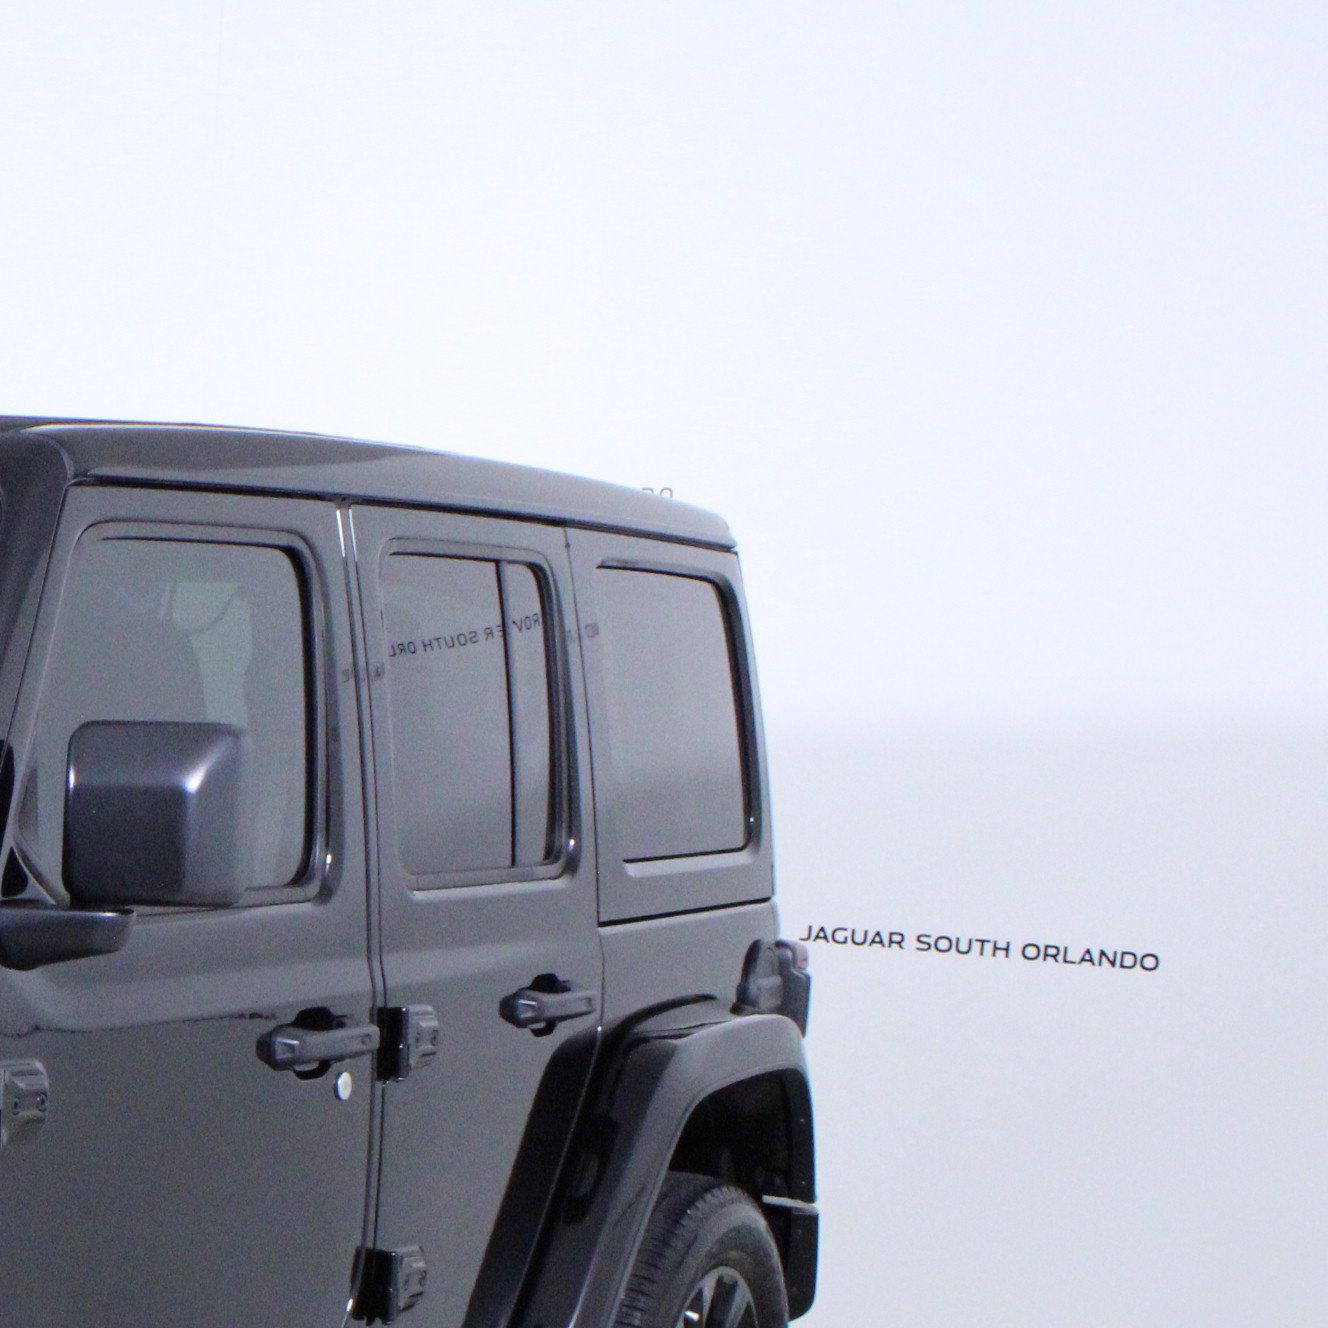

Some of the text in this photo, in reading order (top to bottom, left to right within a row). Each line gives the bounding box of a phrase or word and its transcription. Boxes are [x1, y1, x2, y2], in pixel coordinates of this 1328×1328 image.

[799, 925, 1160, 972] JAGUAR SOUTH ORLANDO
